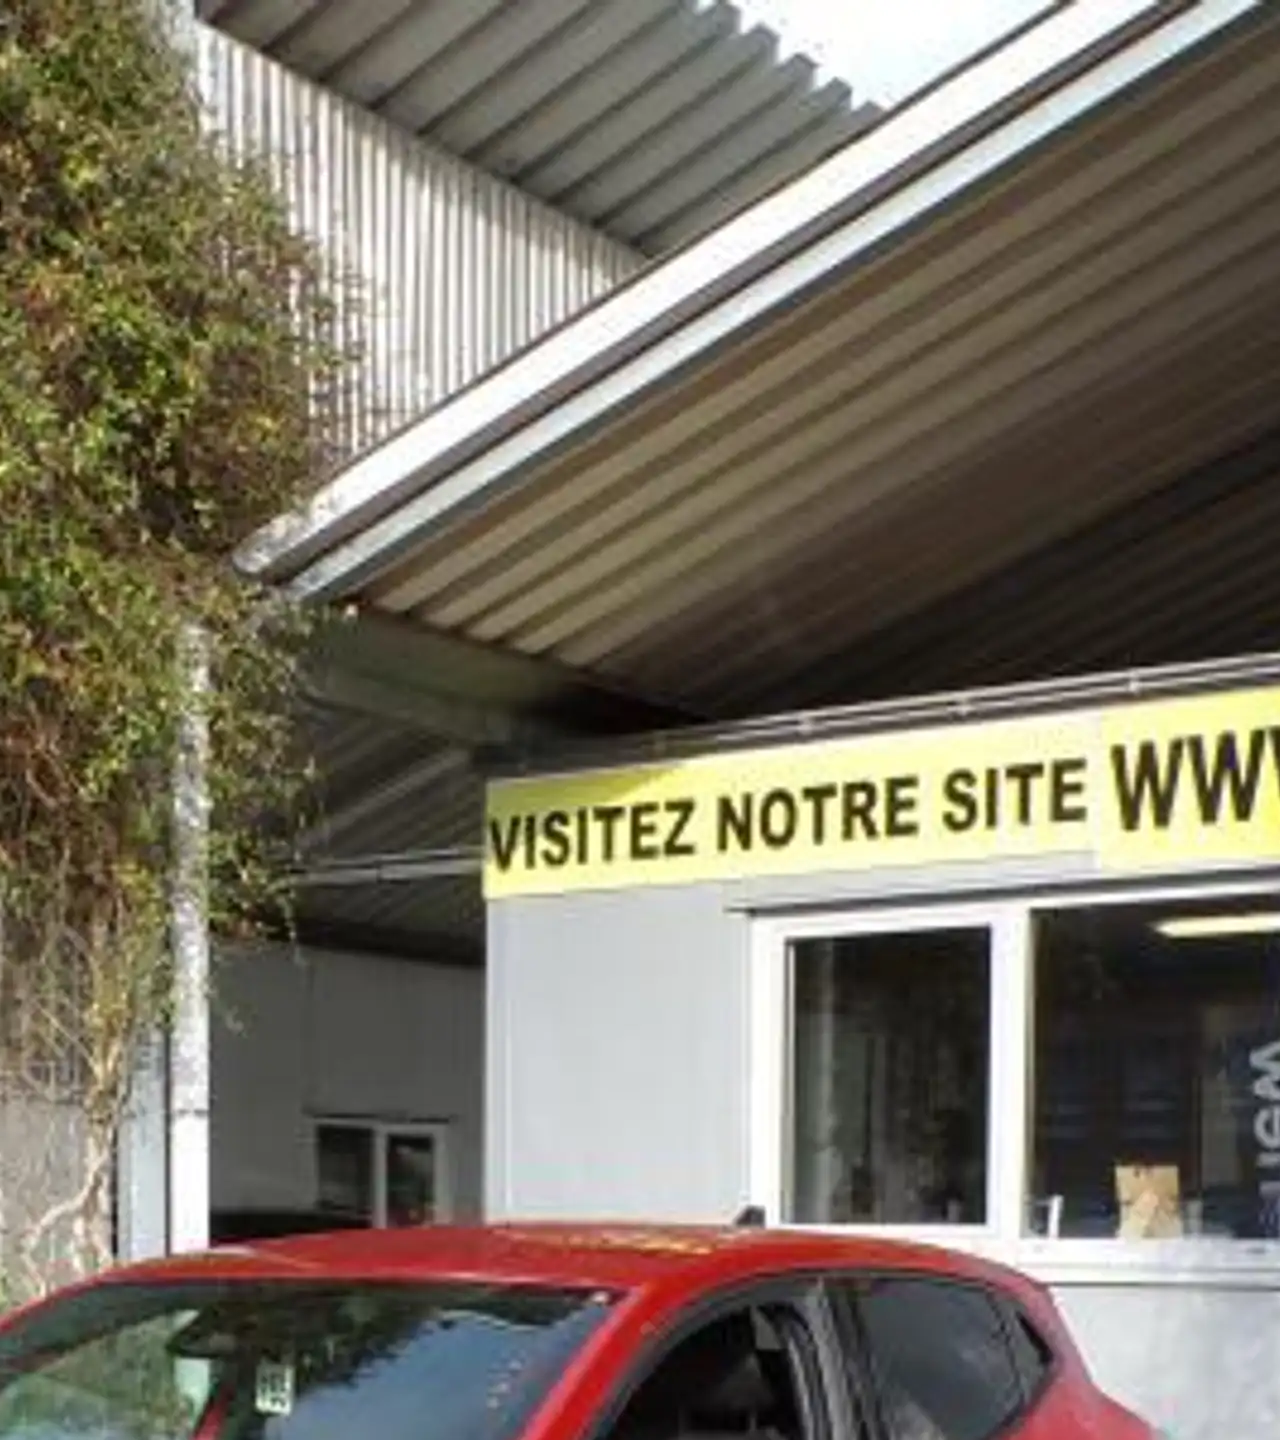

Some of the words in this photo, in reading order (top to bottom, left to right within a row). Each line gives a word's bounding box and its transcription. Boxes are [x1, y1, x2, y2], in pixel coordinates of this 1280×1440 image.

[489, 798, 697, 872] VISITEZ
[716, 775, 921, 852] NOTRE
[941, 757, 1089, 834] SITE
